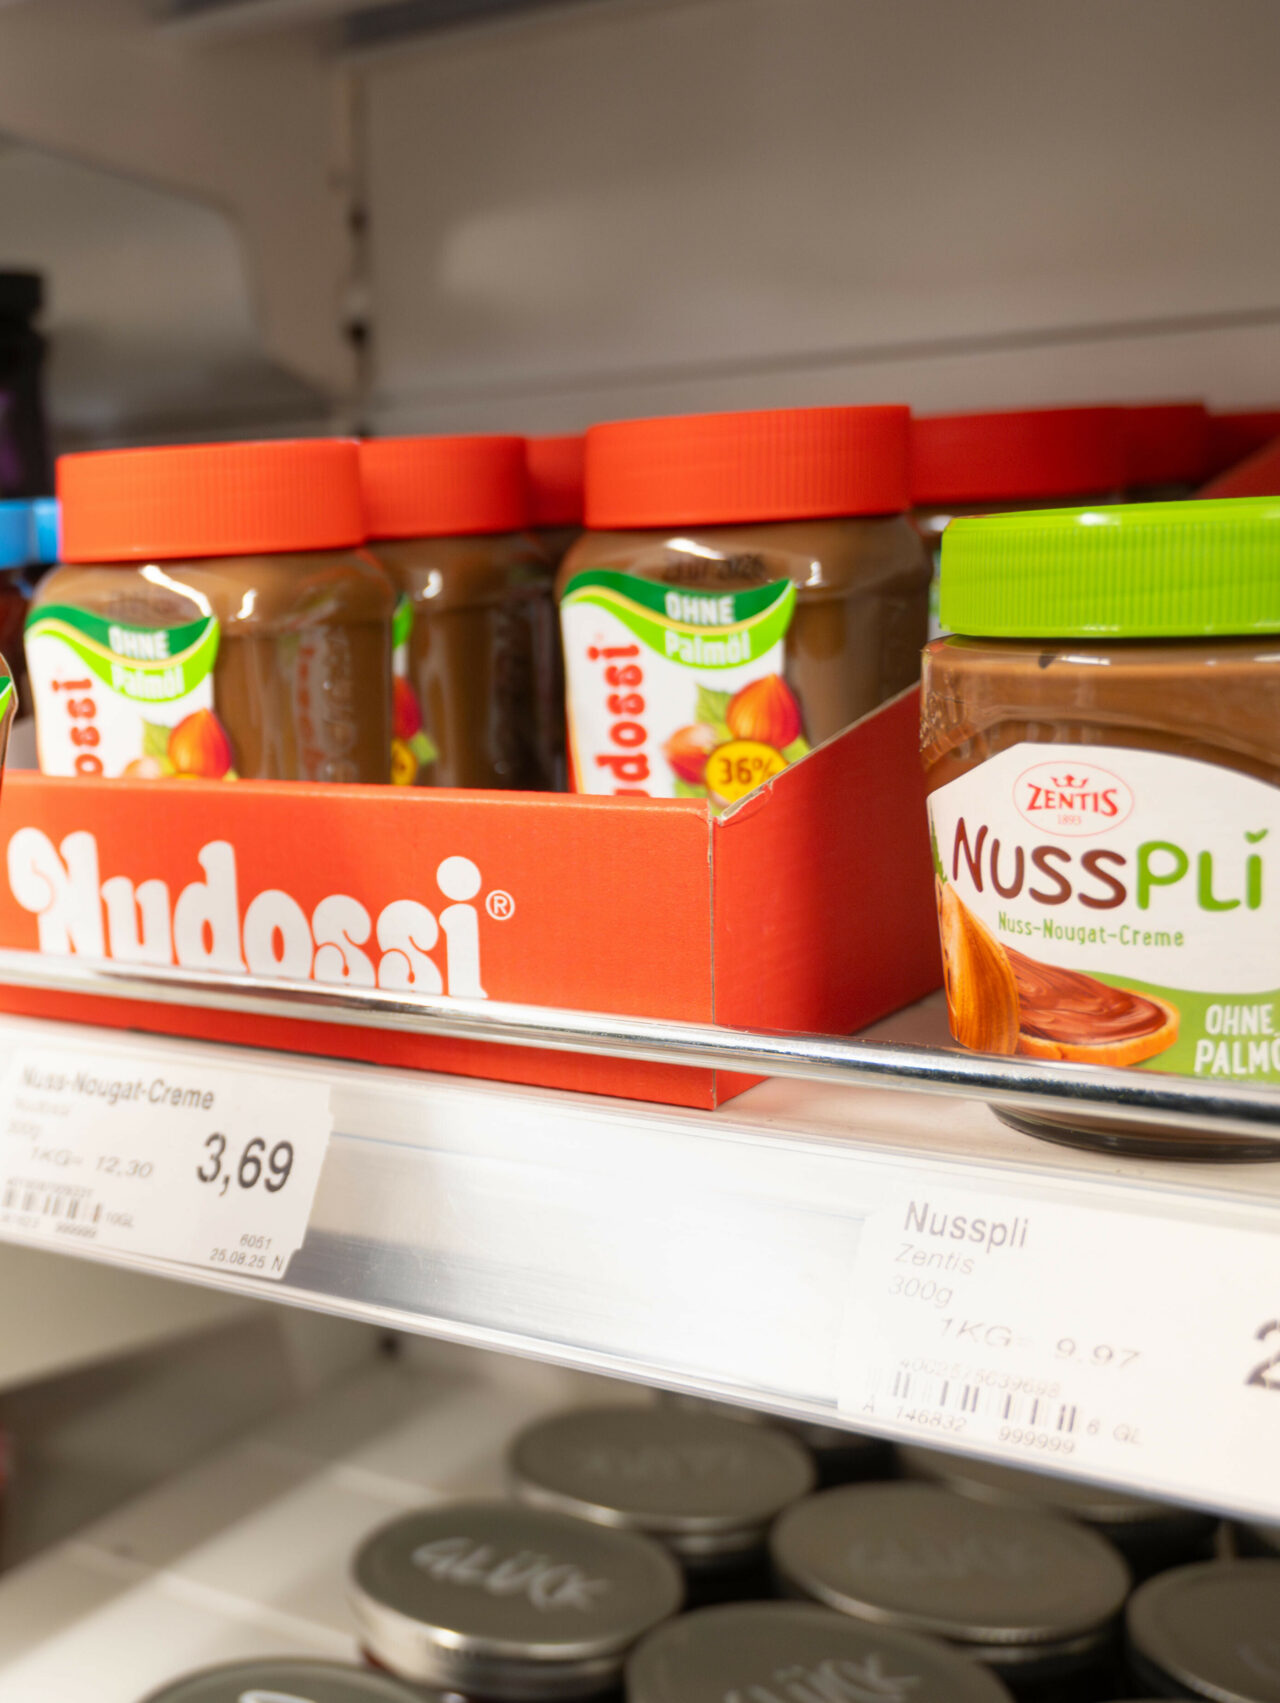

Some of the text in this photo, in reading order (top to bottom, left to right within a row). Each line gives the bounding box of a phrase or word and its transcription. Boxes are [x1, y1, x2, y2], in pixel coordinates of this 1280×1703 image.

[665, 591, 736, 625] OHNE
[108, 626, 170, 660] OHNE
[52, 677, 104, 776] ossi
[588, 644, 650, 797] dossi
[720, 756, 775, 784] 36%
[1027, 783, 1118, 817] ZENTIS
[7, 827, 488, 999] Nudossi
[998, 911, 1185, 947] Nuss-Nougat-Creme
[1205, 1003, 1273, 1035] OHNE
[21, 1067, 214, 1110] Nuss-Nougat-Creme
[197, 1132, 294, 1196] 3,69
[904, 1200, 1029, 1254] Nusspli
[210, 1248, 283, 1271] 25.08.25 N
[894, 1243, 975, 1275] Zentis
[888, 1274, 953, 1309] 300g
[998, 1427, 1076, 1455] 999999
